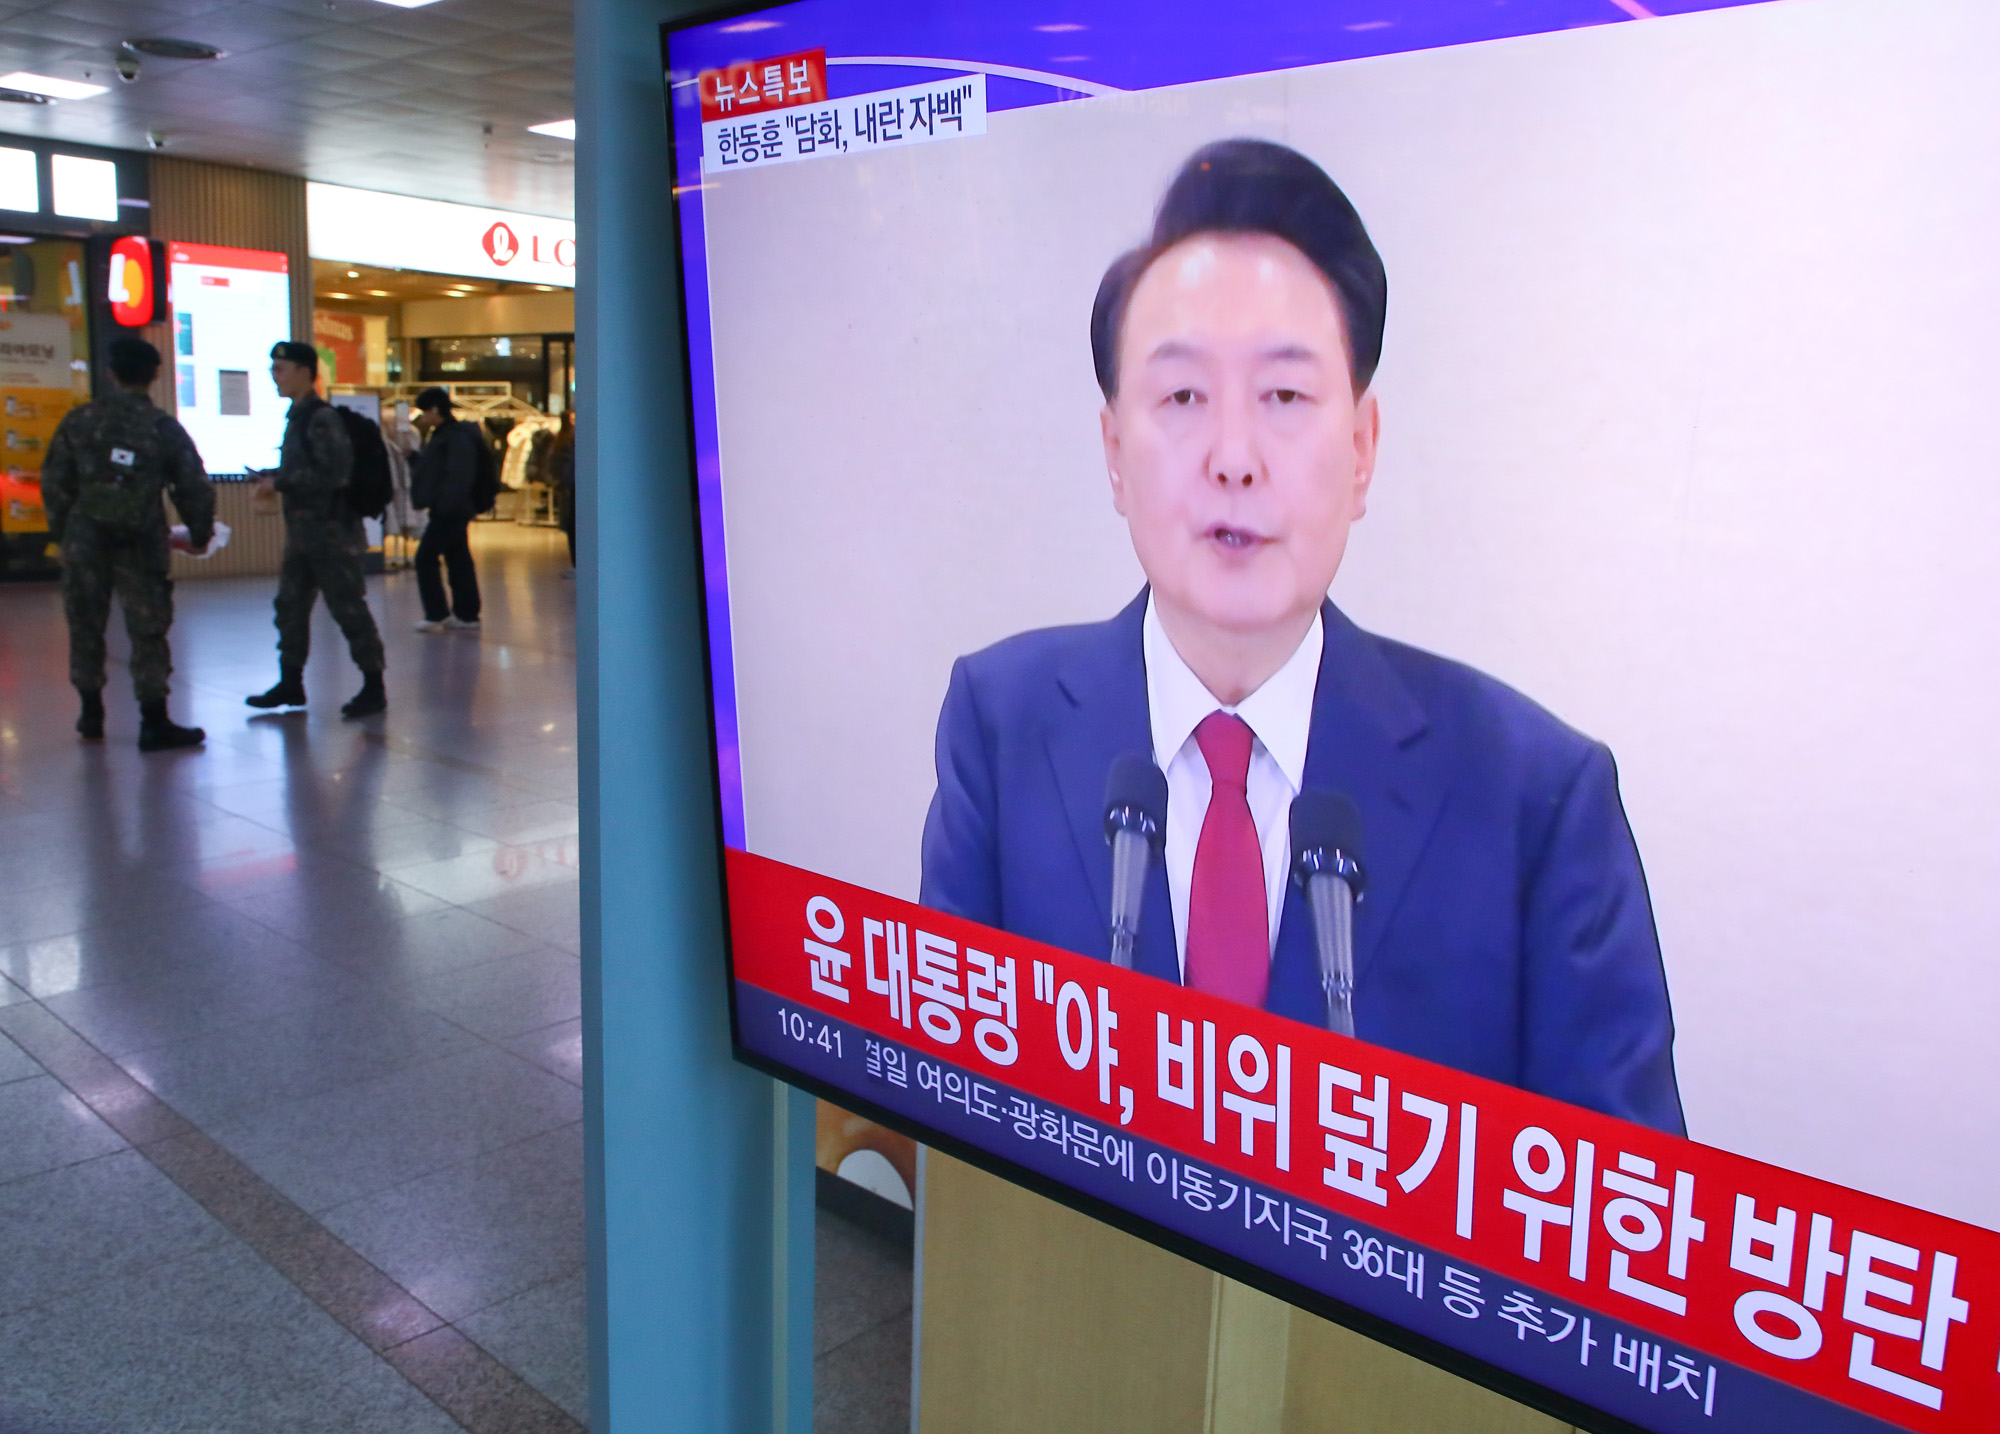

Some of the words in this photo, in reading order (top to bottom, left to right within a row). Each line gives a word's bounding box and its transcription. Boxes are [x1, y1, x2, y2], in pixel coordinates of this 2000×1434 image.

[715, 59, 811, 112] 뉴스특보
[718, 120, 783, 165] 한동훈
[786, 108, 848, 153] "담화,
[855, 98, 904, 144] 내란
[910, 84, 973, 134] 자백"
[778, 1008, 842, 1059] 10:41
[803, 895, 852, 1004] 윤
[862, 915, 1020, 1067] 대통령
[1032, 959, 1136, 1126] "야,
[1156, 1011, 1292, 1173] 비위
[1317, 1061, 1479, 1241] 덮기
[1502, 1125, 1706, 1317] 위한
[1729, 1192, 1970, 1412] 방탄
[1146, 1151, 1333, 1261] 이동기지국
[1341, 1228, 1426, 1300] 36대
[1437, 1263, 1486, 1321] 등
[1496, 1289, 1598, 1368] 추가
[1612, 1331, 1718, 1418] 배치
